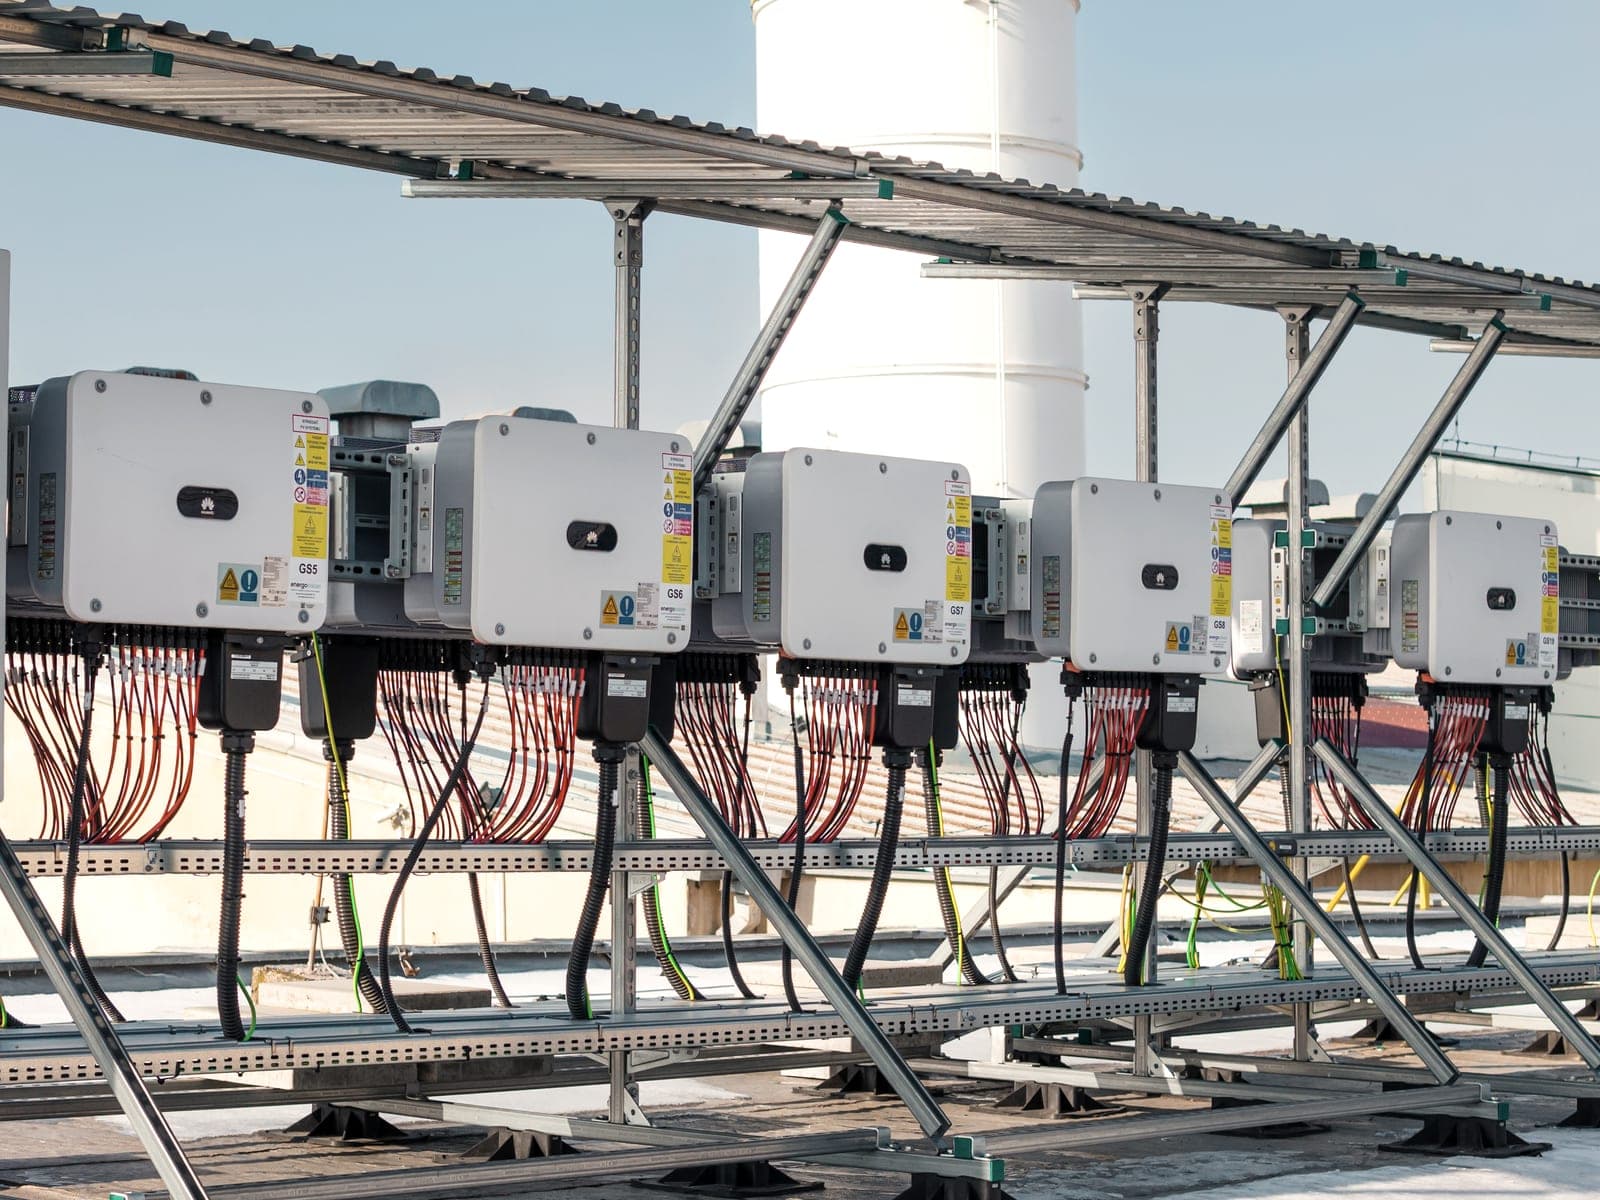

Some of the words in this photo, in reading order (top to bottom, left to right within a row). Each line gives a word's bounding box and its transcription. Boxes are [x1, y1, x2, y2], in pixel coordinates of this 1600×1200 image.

[299, 563, 318, 575] GS5
[667, 588, 684, 599] GS6
[950, 605, 964, 615] GS7
[1213, 620, 1226, 629] GS8
